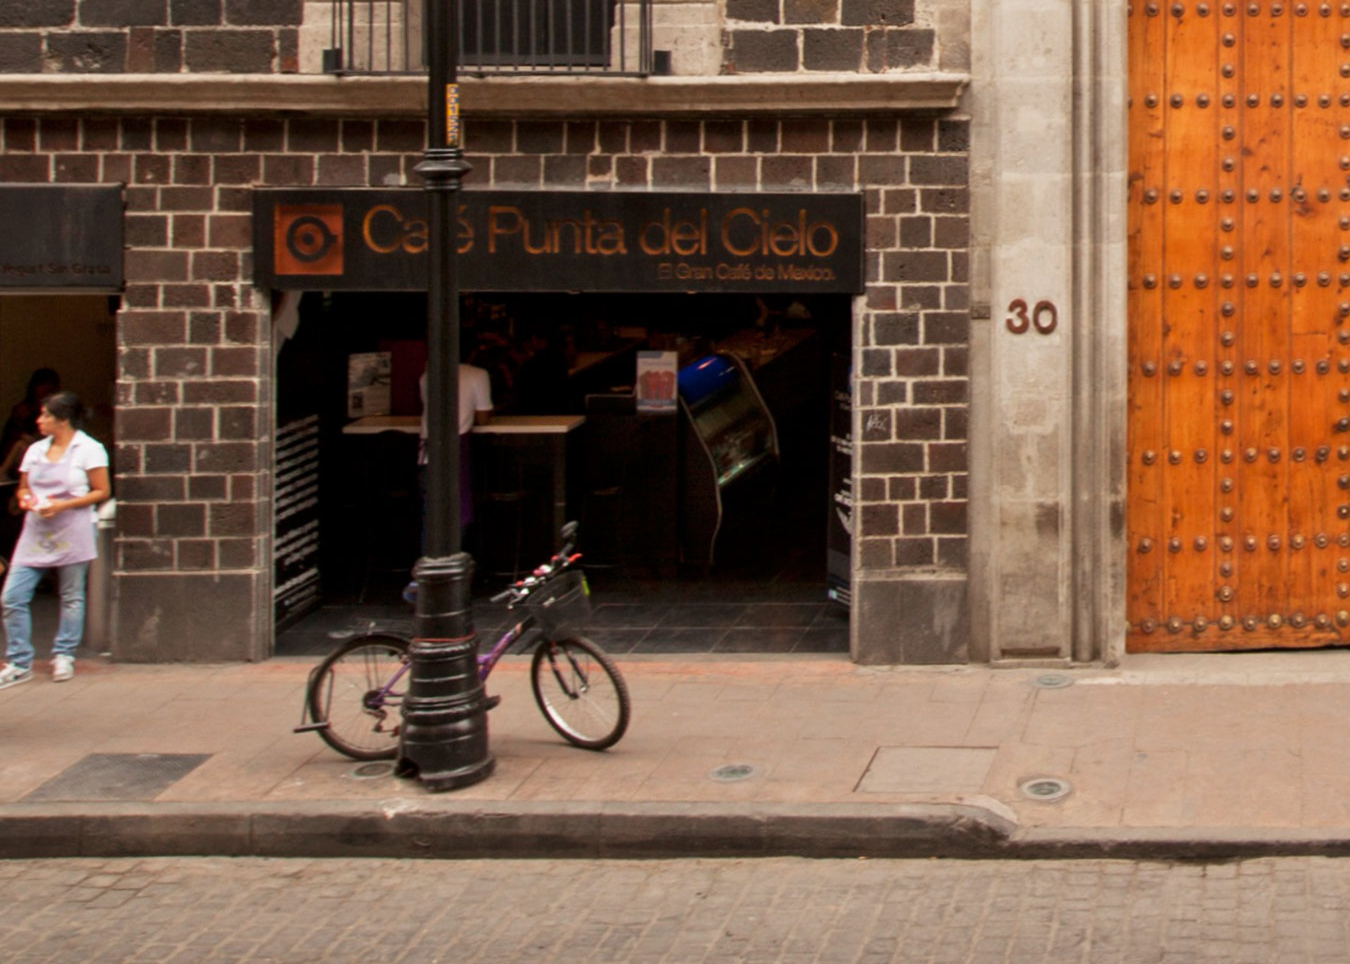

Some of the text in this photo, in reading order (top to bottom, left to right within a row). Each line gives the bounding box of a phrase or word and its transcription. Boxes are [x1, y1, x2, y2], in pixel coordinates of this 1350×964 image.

[362, 205, 839, 258] Caé Punta del Cielo
[674, 262, 713, 280] Gran
[716, 262, 752, 281] Café
[754, 264, 774, 281] de
[1006, 298, 1058, 335] 30
